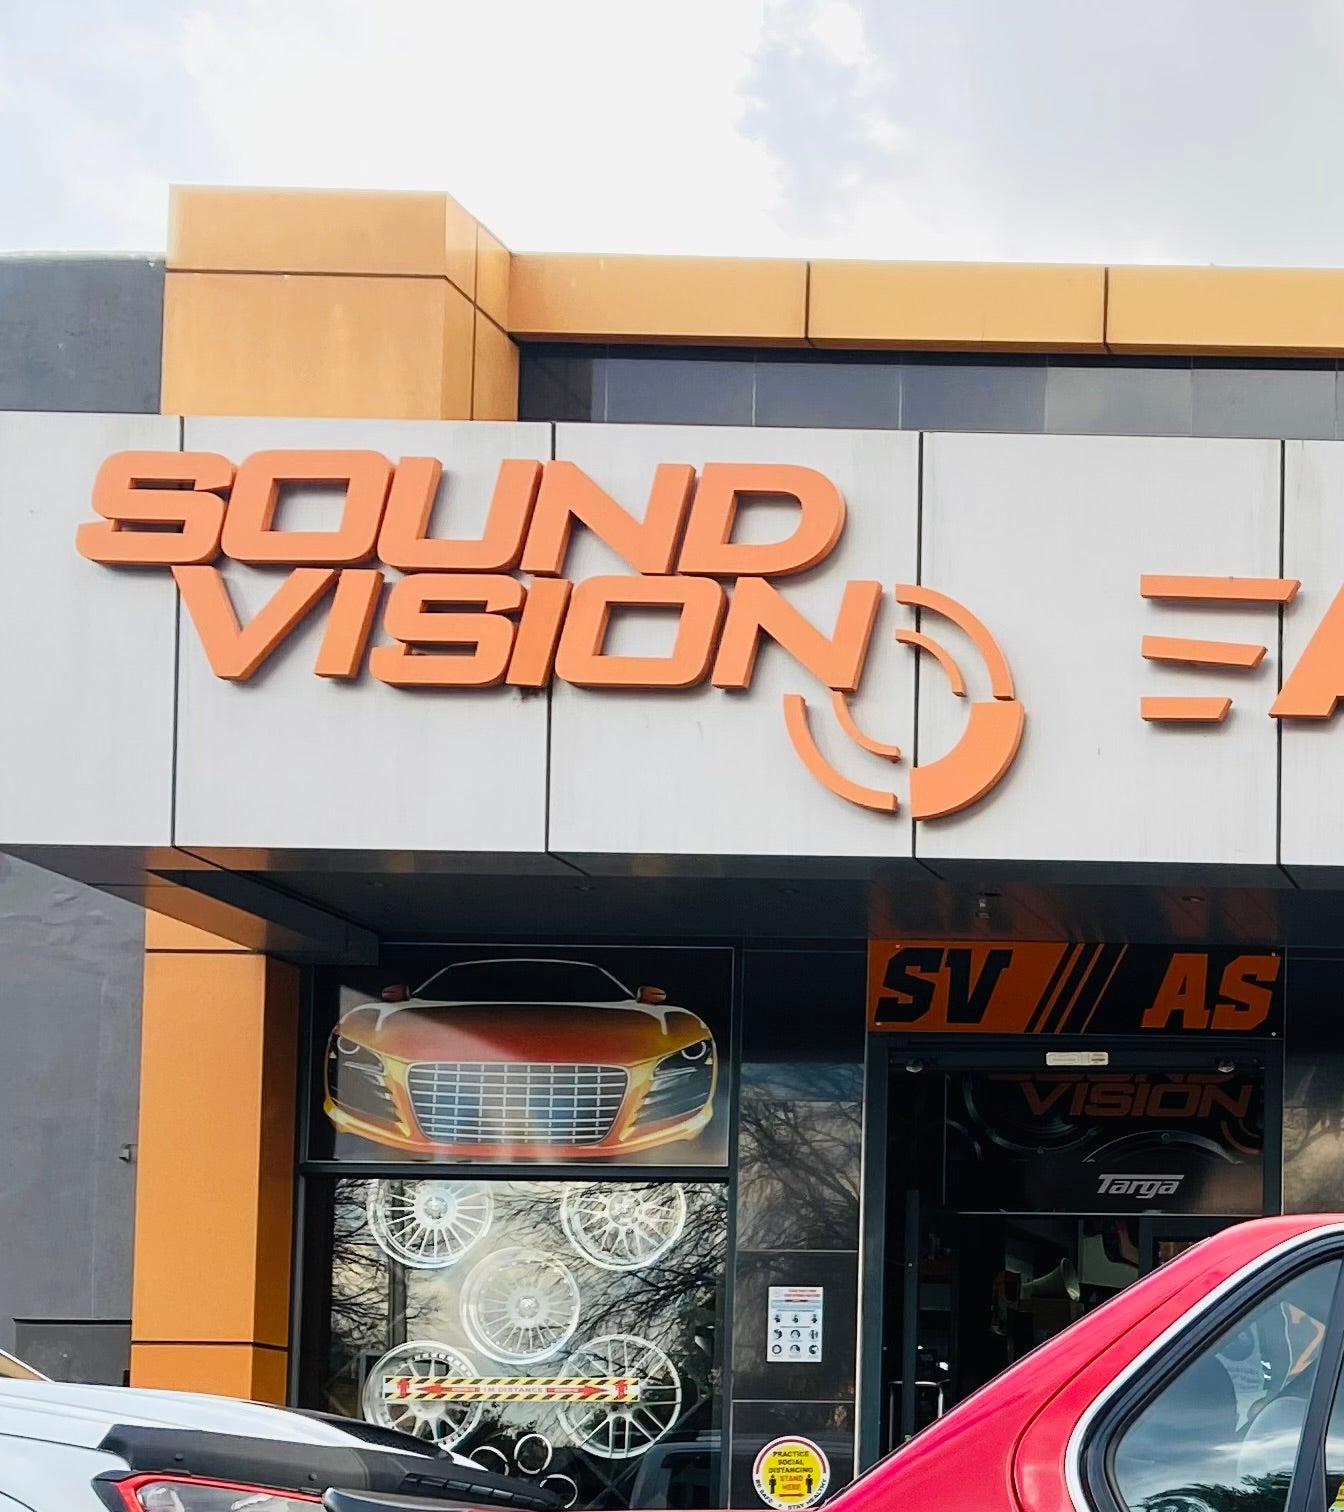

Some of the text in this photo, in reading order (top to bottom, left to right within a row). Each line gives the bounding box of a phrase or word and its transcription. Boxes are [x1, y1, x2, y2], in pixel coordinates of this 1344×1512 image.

[76, 449, 846, 578] SOUND
[172, 565, 883, 692] VISION
[874, 947, 1281, 1031] SV AS
[1020, 1082, 1253, 1118] VISION
[1096, 1174, 1185, 1199] Targa
